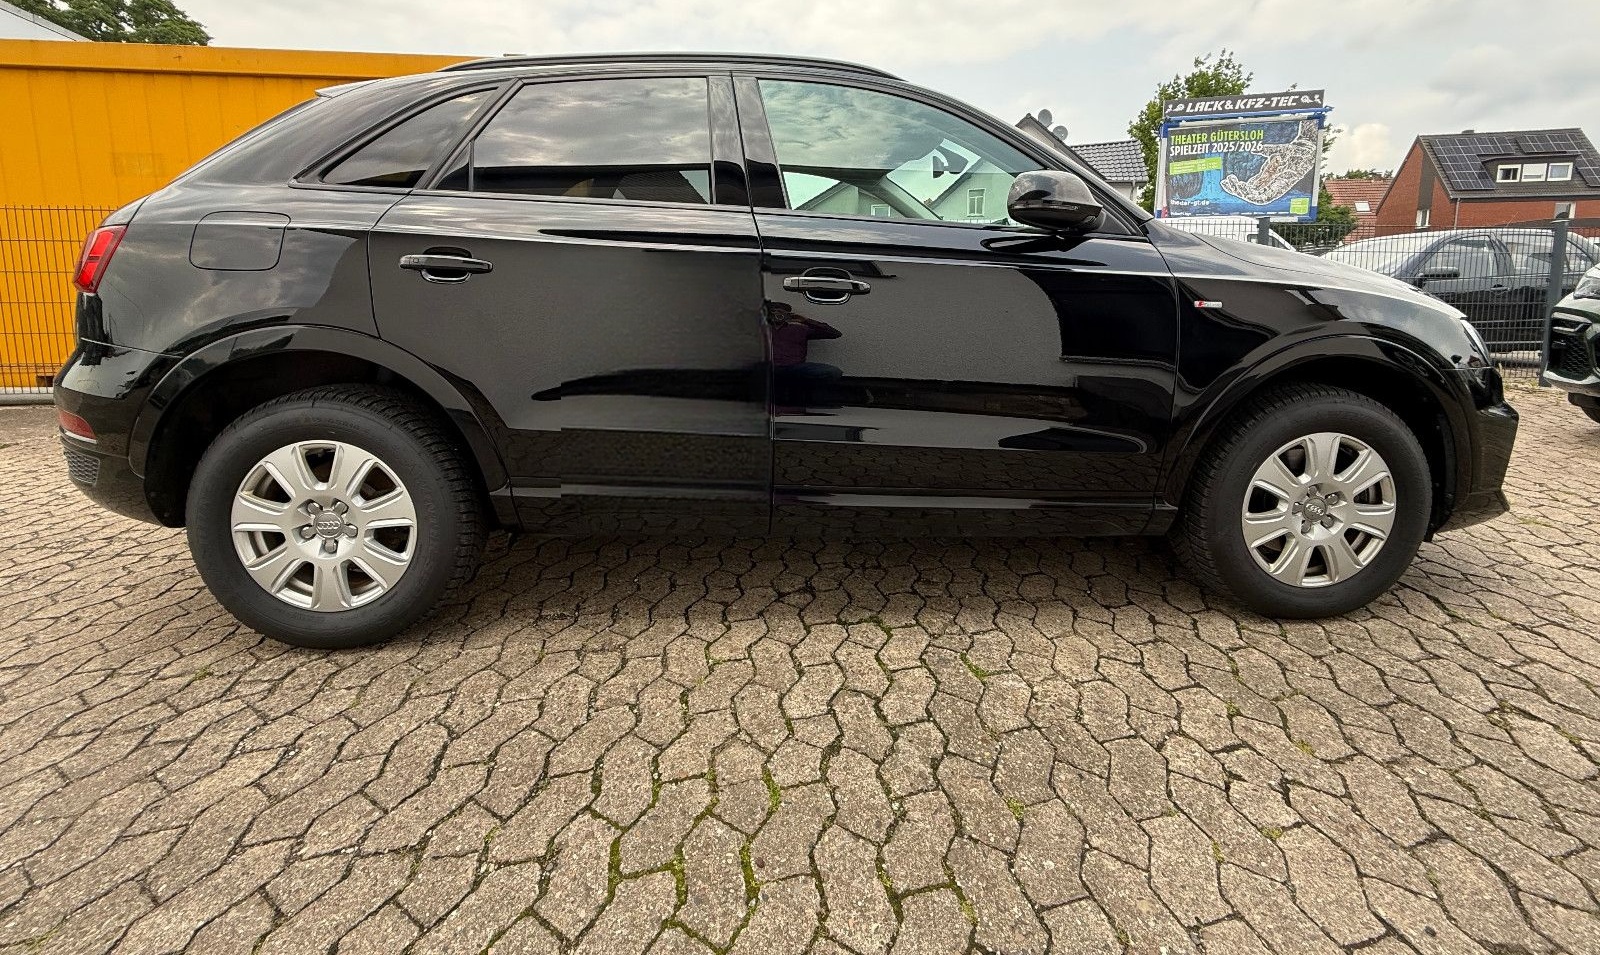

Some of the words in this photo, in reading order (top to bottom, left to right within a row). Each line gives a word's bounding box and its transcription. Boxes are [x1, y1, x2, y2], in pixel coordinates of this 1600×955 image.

[1170, 132, 1208, 146] THEATER
[1210, 129, 1264, 143] GÜTERSLOH
[1169, 143, 1210, 157] SPIELZEIT
[1211, 140, 1264, 154] 2025/2026
